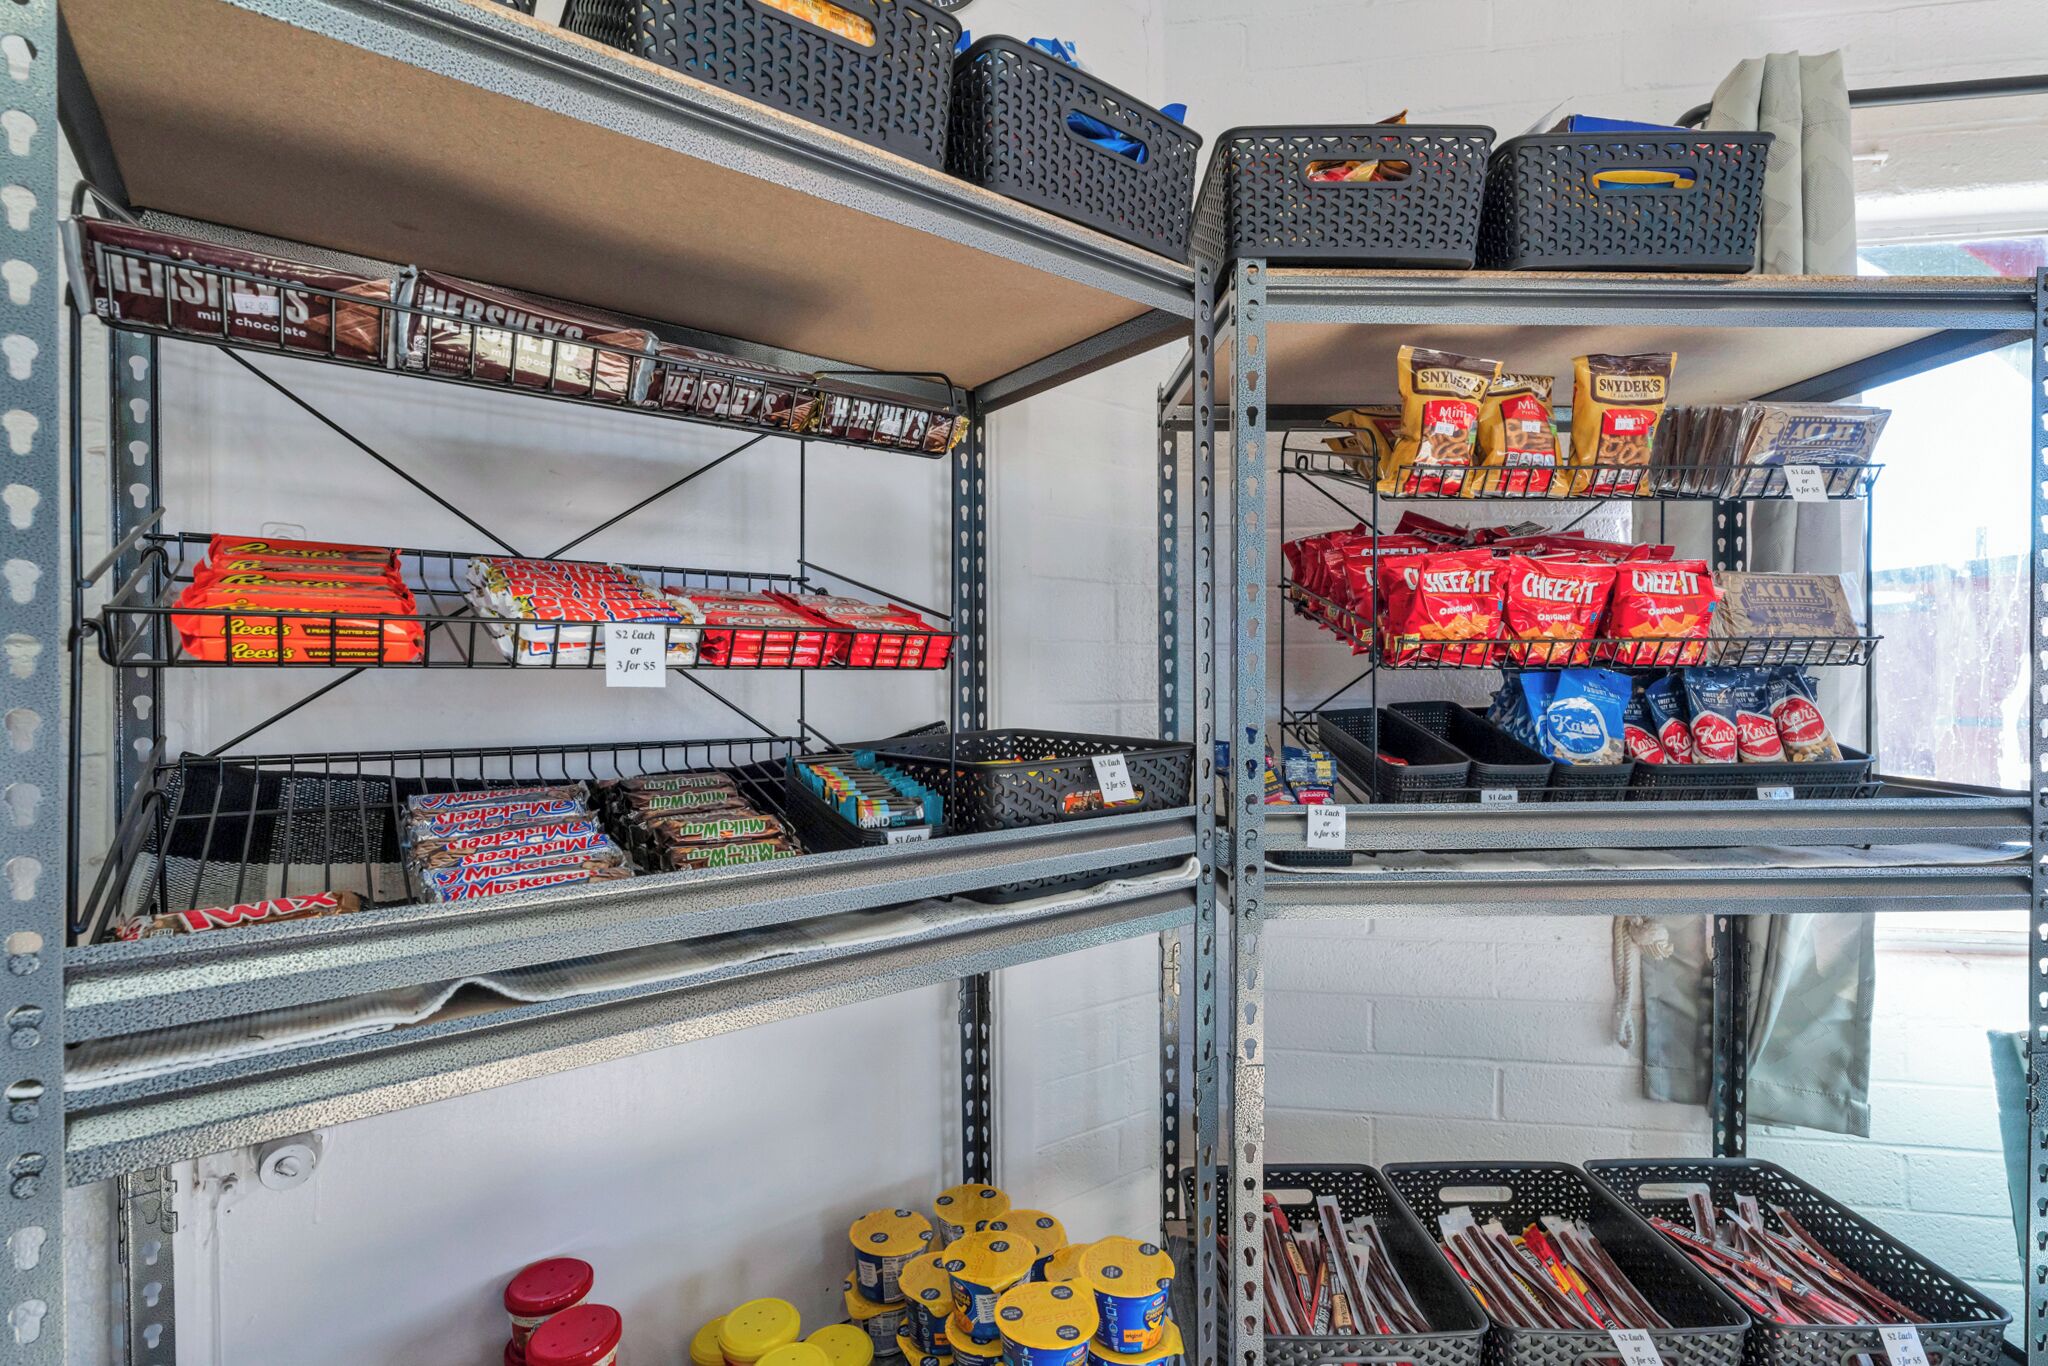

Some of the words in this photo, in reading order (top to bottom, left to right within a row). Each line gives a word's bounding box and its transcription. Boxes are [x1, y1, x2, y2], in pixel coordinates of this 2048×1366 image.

[234, 316, 308, 338] chocoate
[490, 349, 517, 361] mil
[1599, 378, 1661, 394] SNYDER'S
[1755, 582, 1789, 599] ACT
[1793, 583, 1815, 598] II
[615, 629, 628, 640] $2
[631, 629, 656, 640] Each
[630, 647, 642, 656] or
[616, 660, 622, 671] 3
[623, 660, 641, 673] for
[643, 661, 656, 671] $5
[435, 801, 551, 825] Musketeers
[1324, 809, 1340, 817] Each
[858, 815, 890, 829] KIND
[446, 823, 569, 851] Musketeers
[905, 834, 922, 844] Each
[1318, 829, 1330, 839] for
[462, 837, 588, 866] Musketeers
